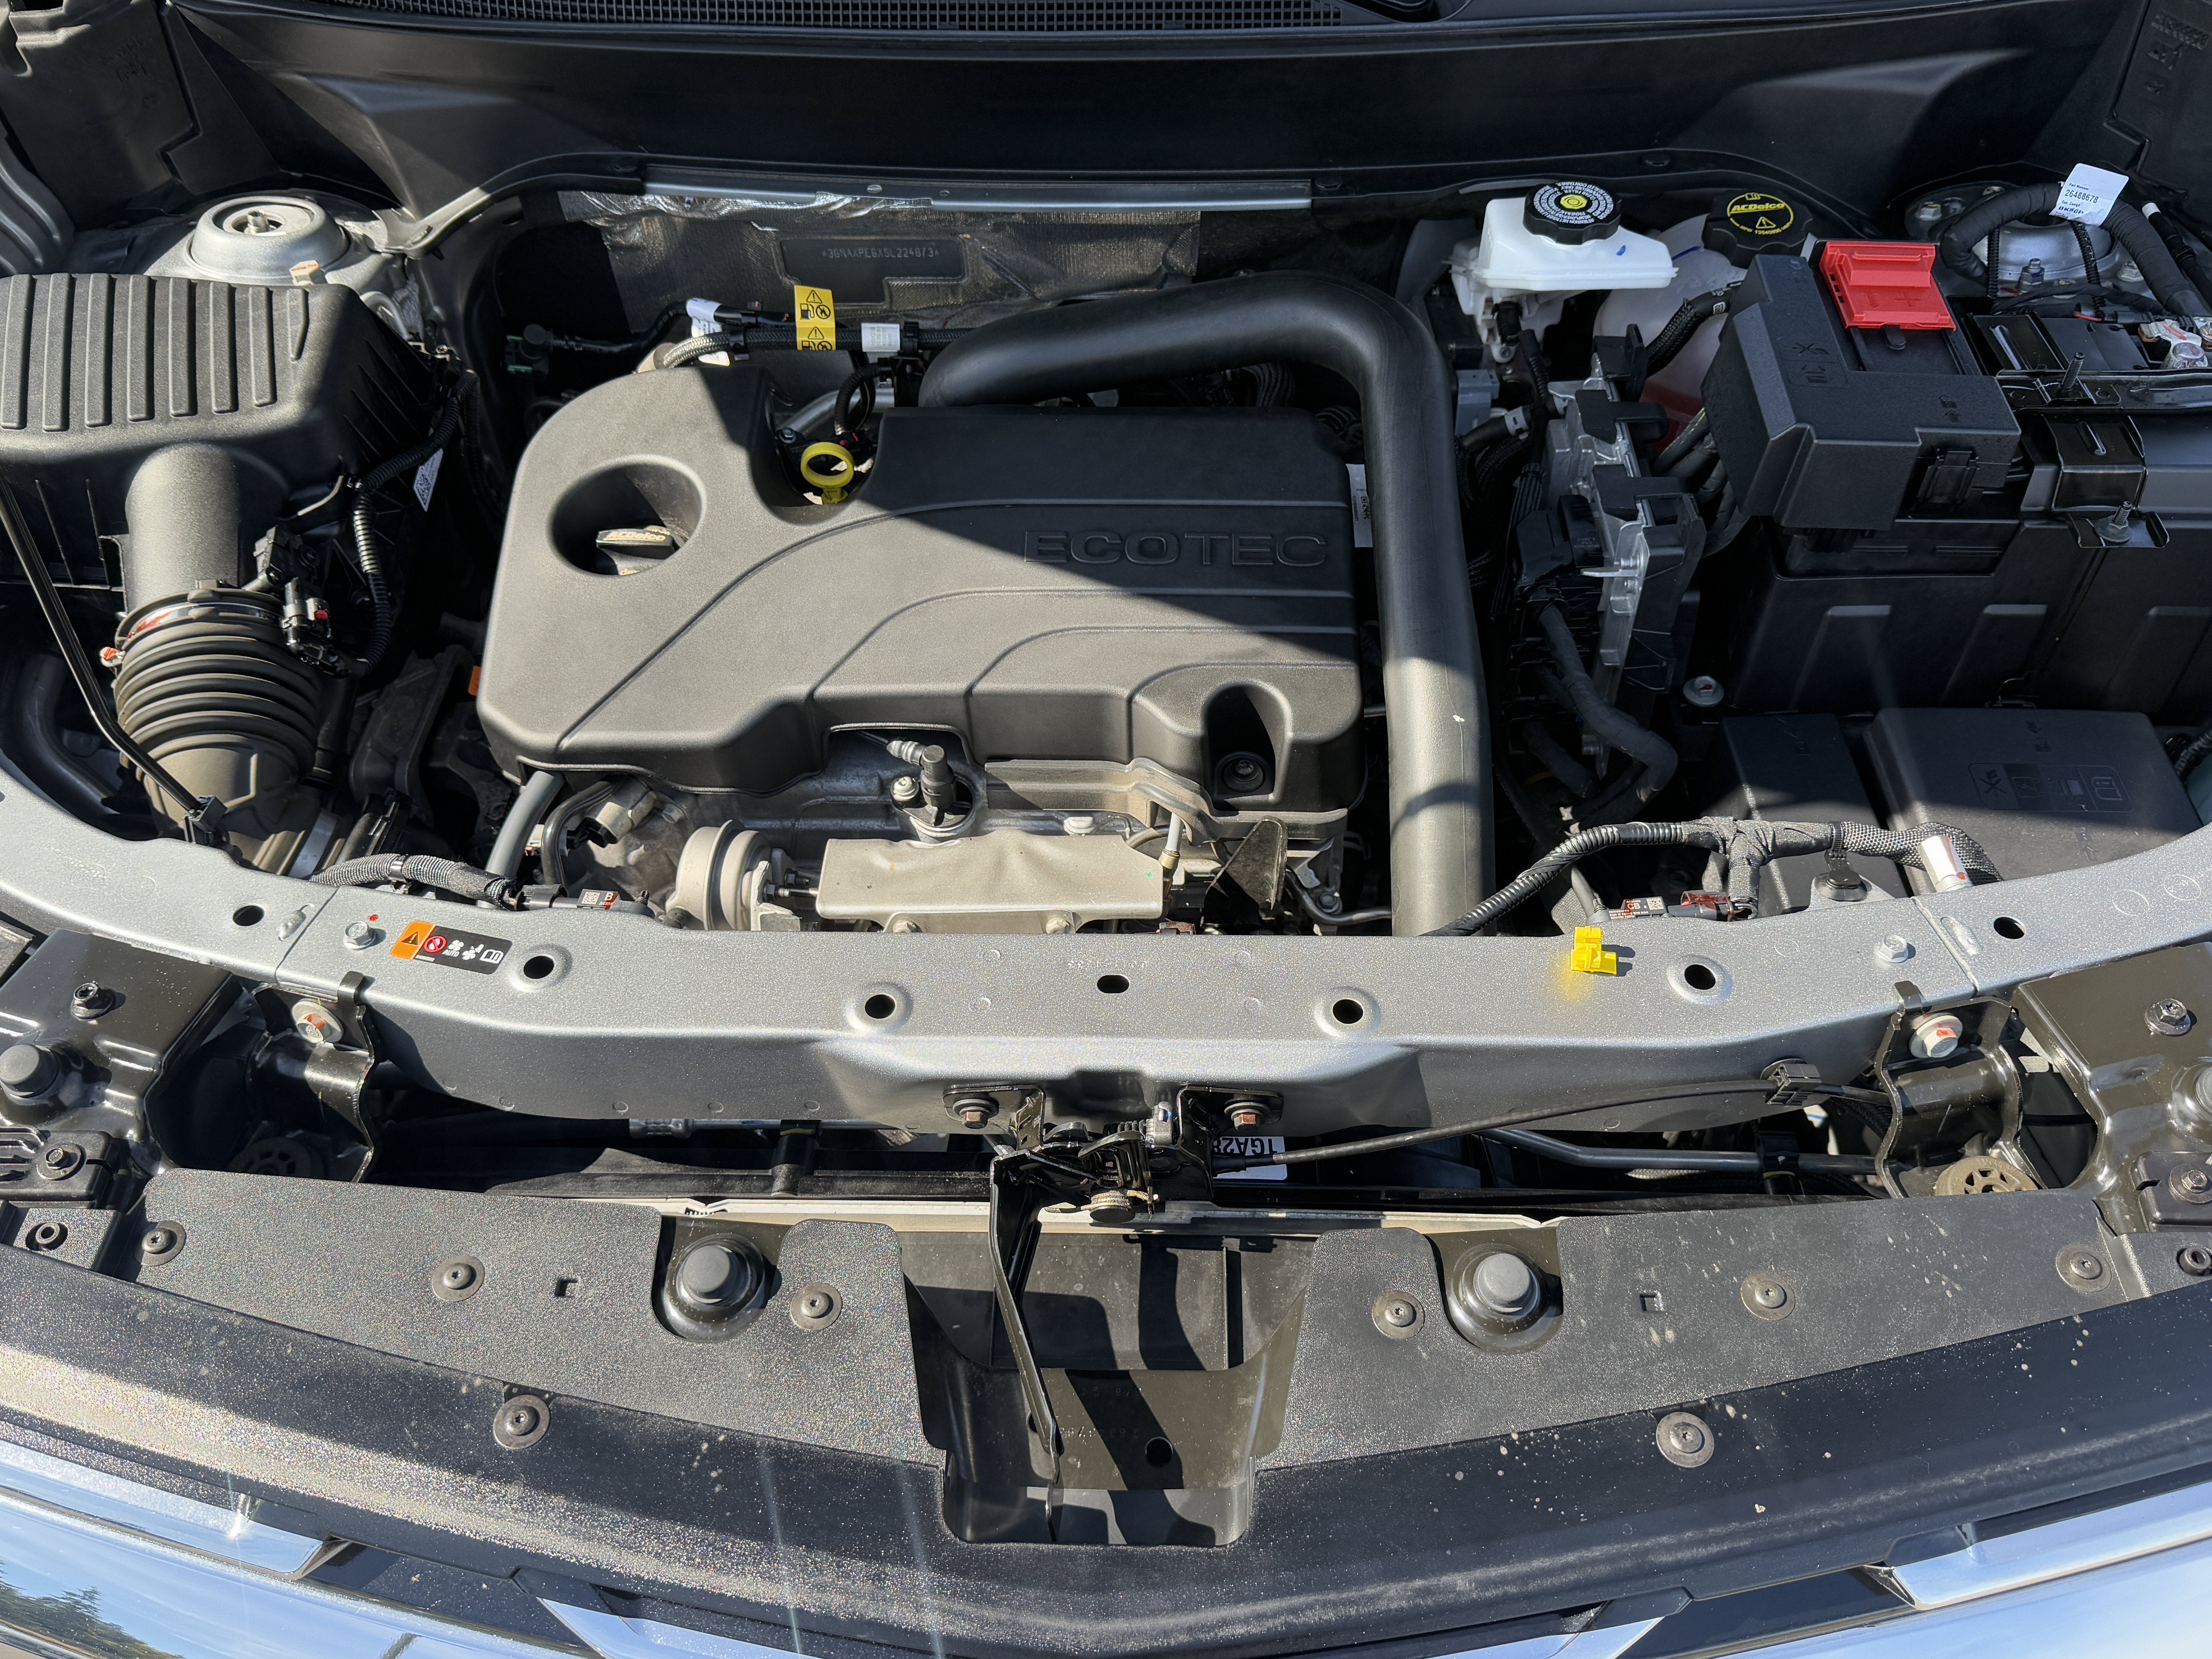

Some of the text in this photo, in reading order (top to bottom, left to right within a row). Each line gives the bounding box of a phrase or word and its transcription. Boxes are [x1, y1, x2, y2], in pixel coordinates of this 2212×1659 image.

[2065, 189, 2099, 203] 26488678
[1731, 203, 1785, 211] ACDelco
[606, 531, 666, 541] ACDelco
[1024, 530, 1327, 567] ECOTEC
[605, 892, 613, 900] B
